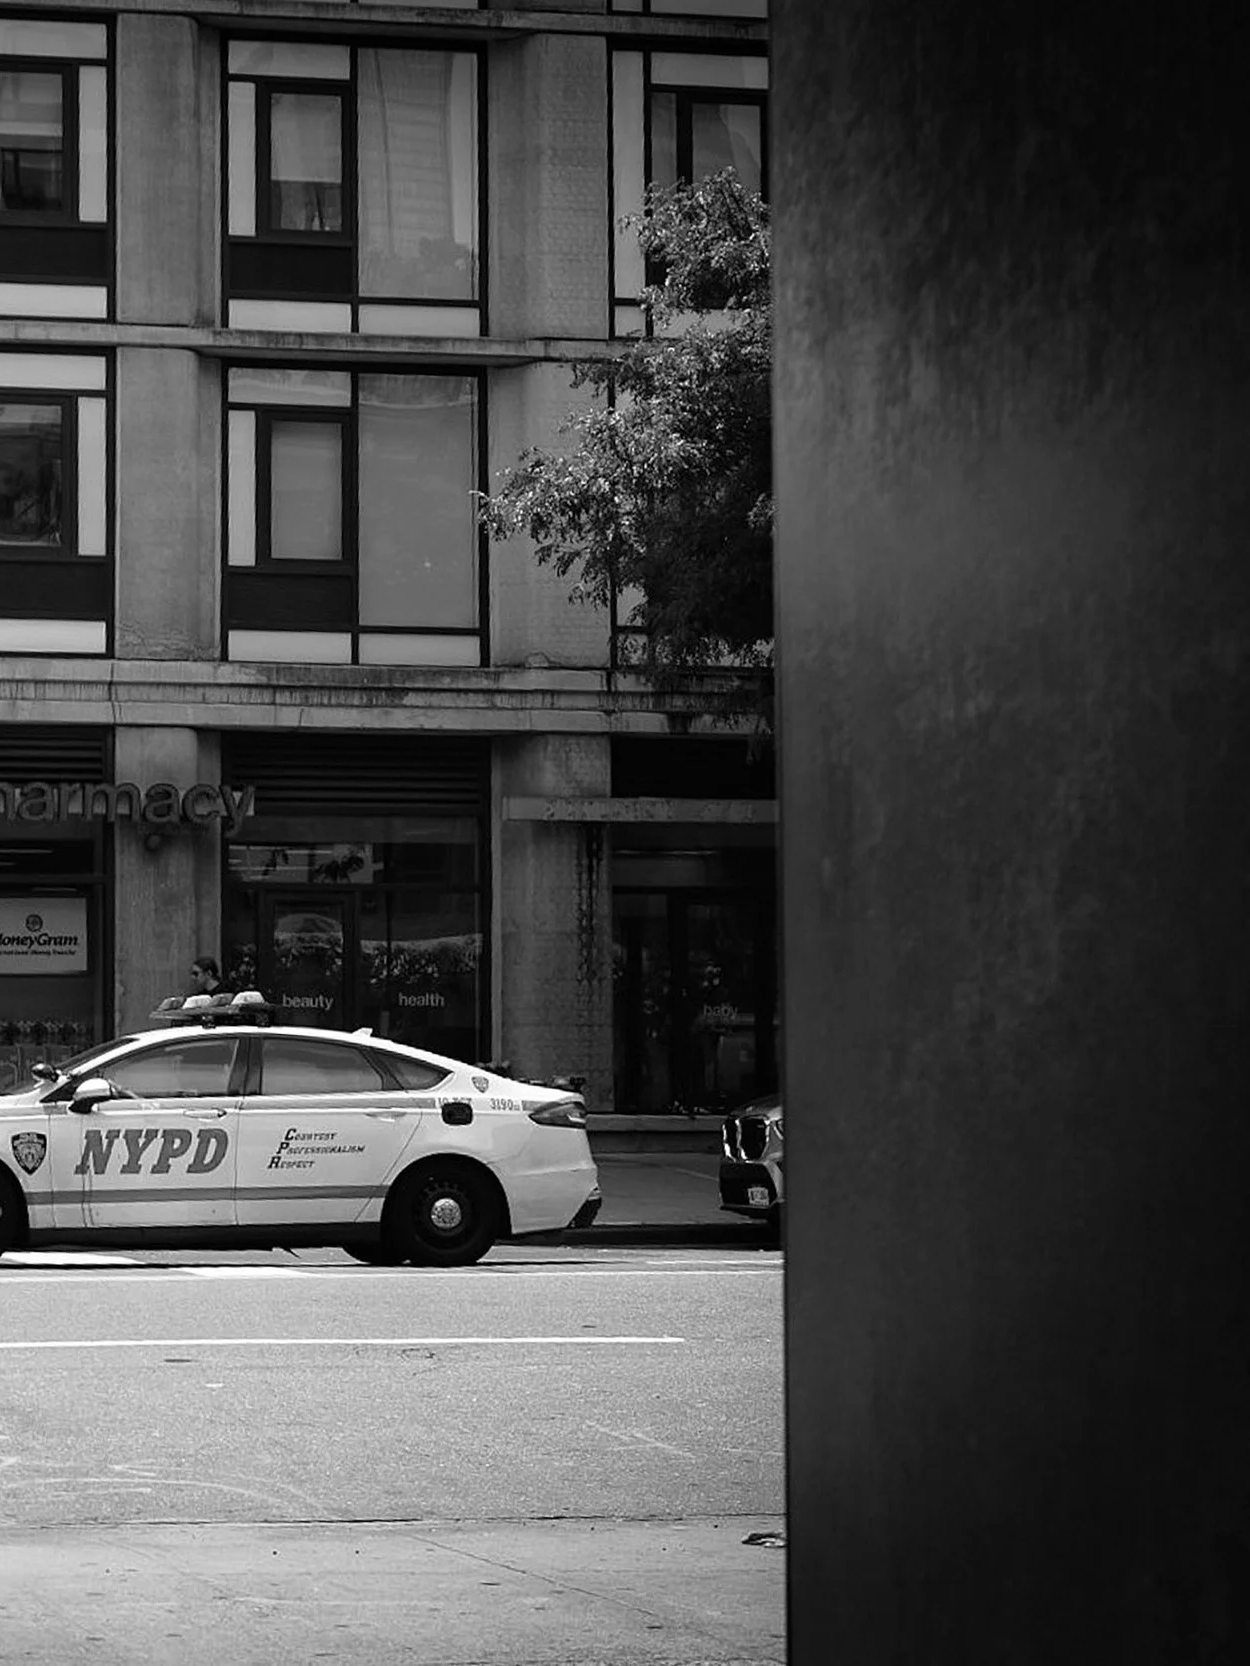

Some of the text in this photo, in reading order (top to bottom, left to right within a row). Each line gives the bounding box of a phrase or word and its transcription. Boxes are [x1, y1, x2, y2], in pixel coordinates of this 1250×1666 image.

[281, 994, 334, 1011] beauty
[398, 992, 445, 1008] health
[73, 1128, 230, 1175] NYPD
